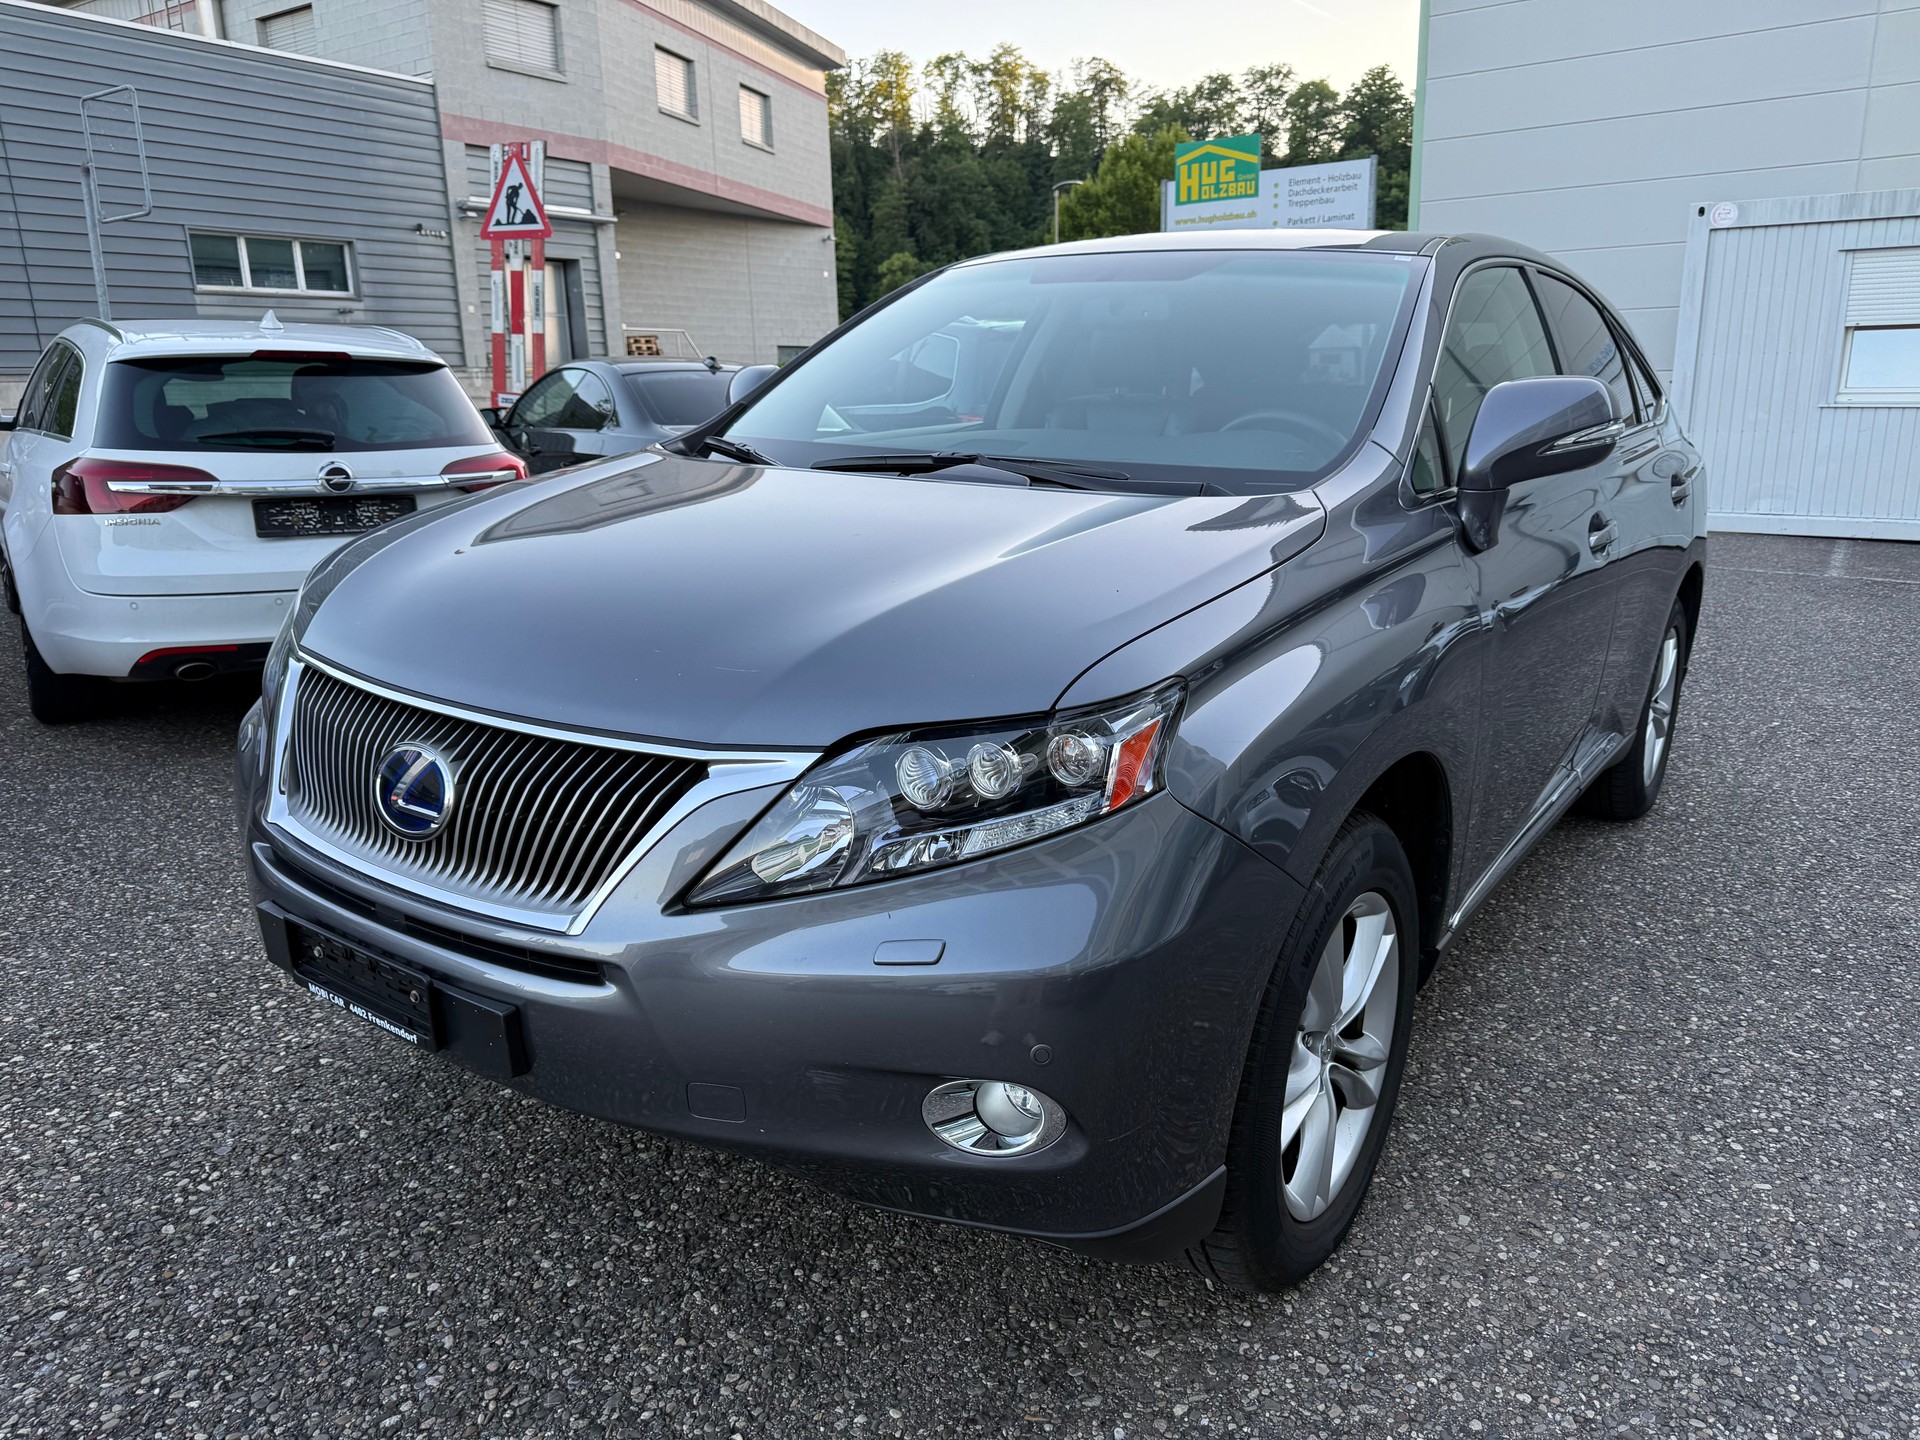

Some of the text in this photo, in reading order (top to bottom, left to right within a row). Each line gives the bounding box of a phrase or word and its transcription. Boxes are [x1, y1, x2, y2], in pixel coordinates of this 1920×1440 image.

[1288, 176, 1321, 187] Element
[1327, 172, 1362, 183] Holzbau
[1287, 183, 1359, 198] Dachdeckerarbeit
[1288, 196, 1336, 208] Treppenbau
[1174, 210, 1257, 225] www.hugholzbau.ch
[1287, 215, 1316, 226] Parkett
[1322, 213, 1355, 223] Laminat
[104, 518, 161, 527] INSIGNIA
[308, 982, 418, 1044] MOBI CAR 4402 Frenkendorf
